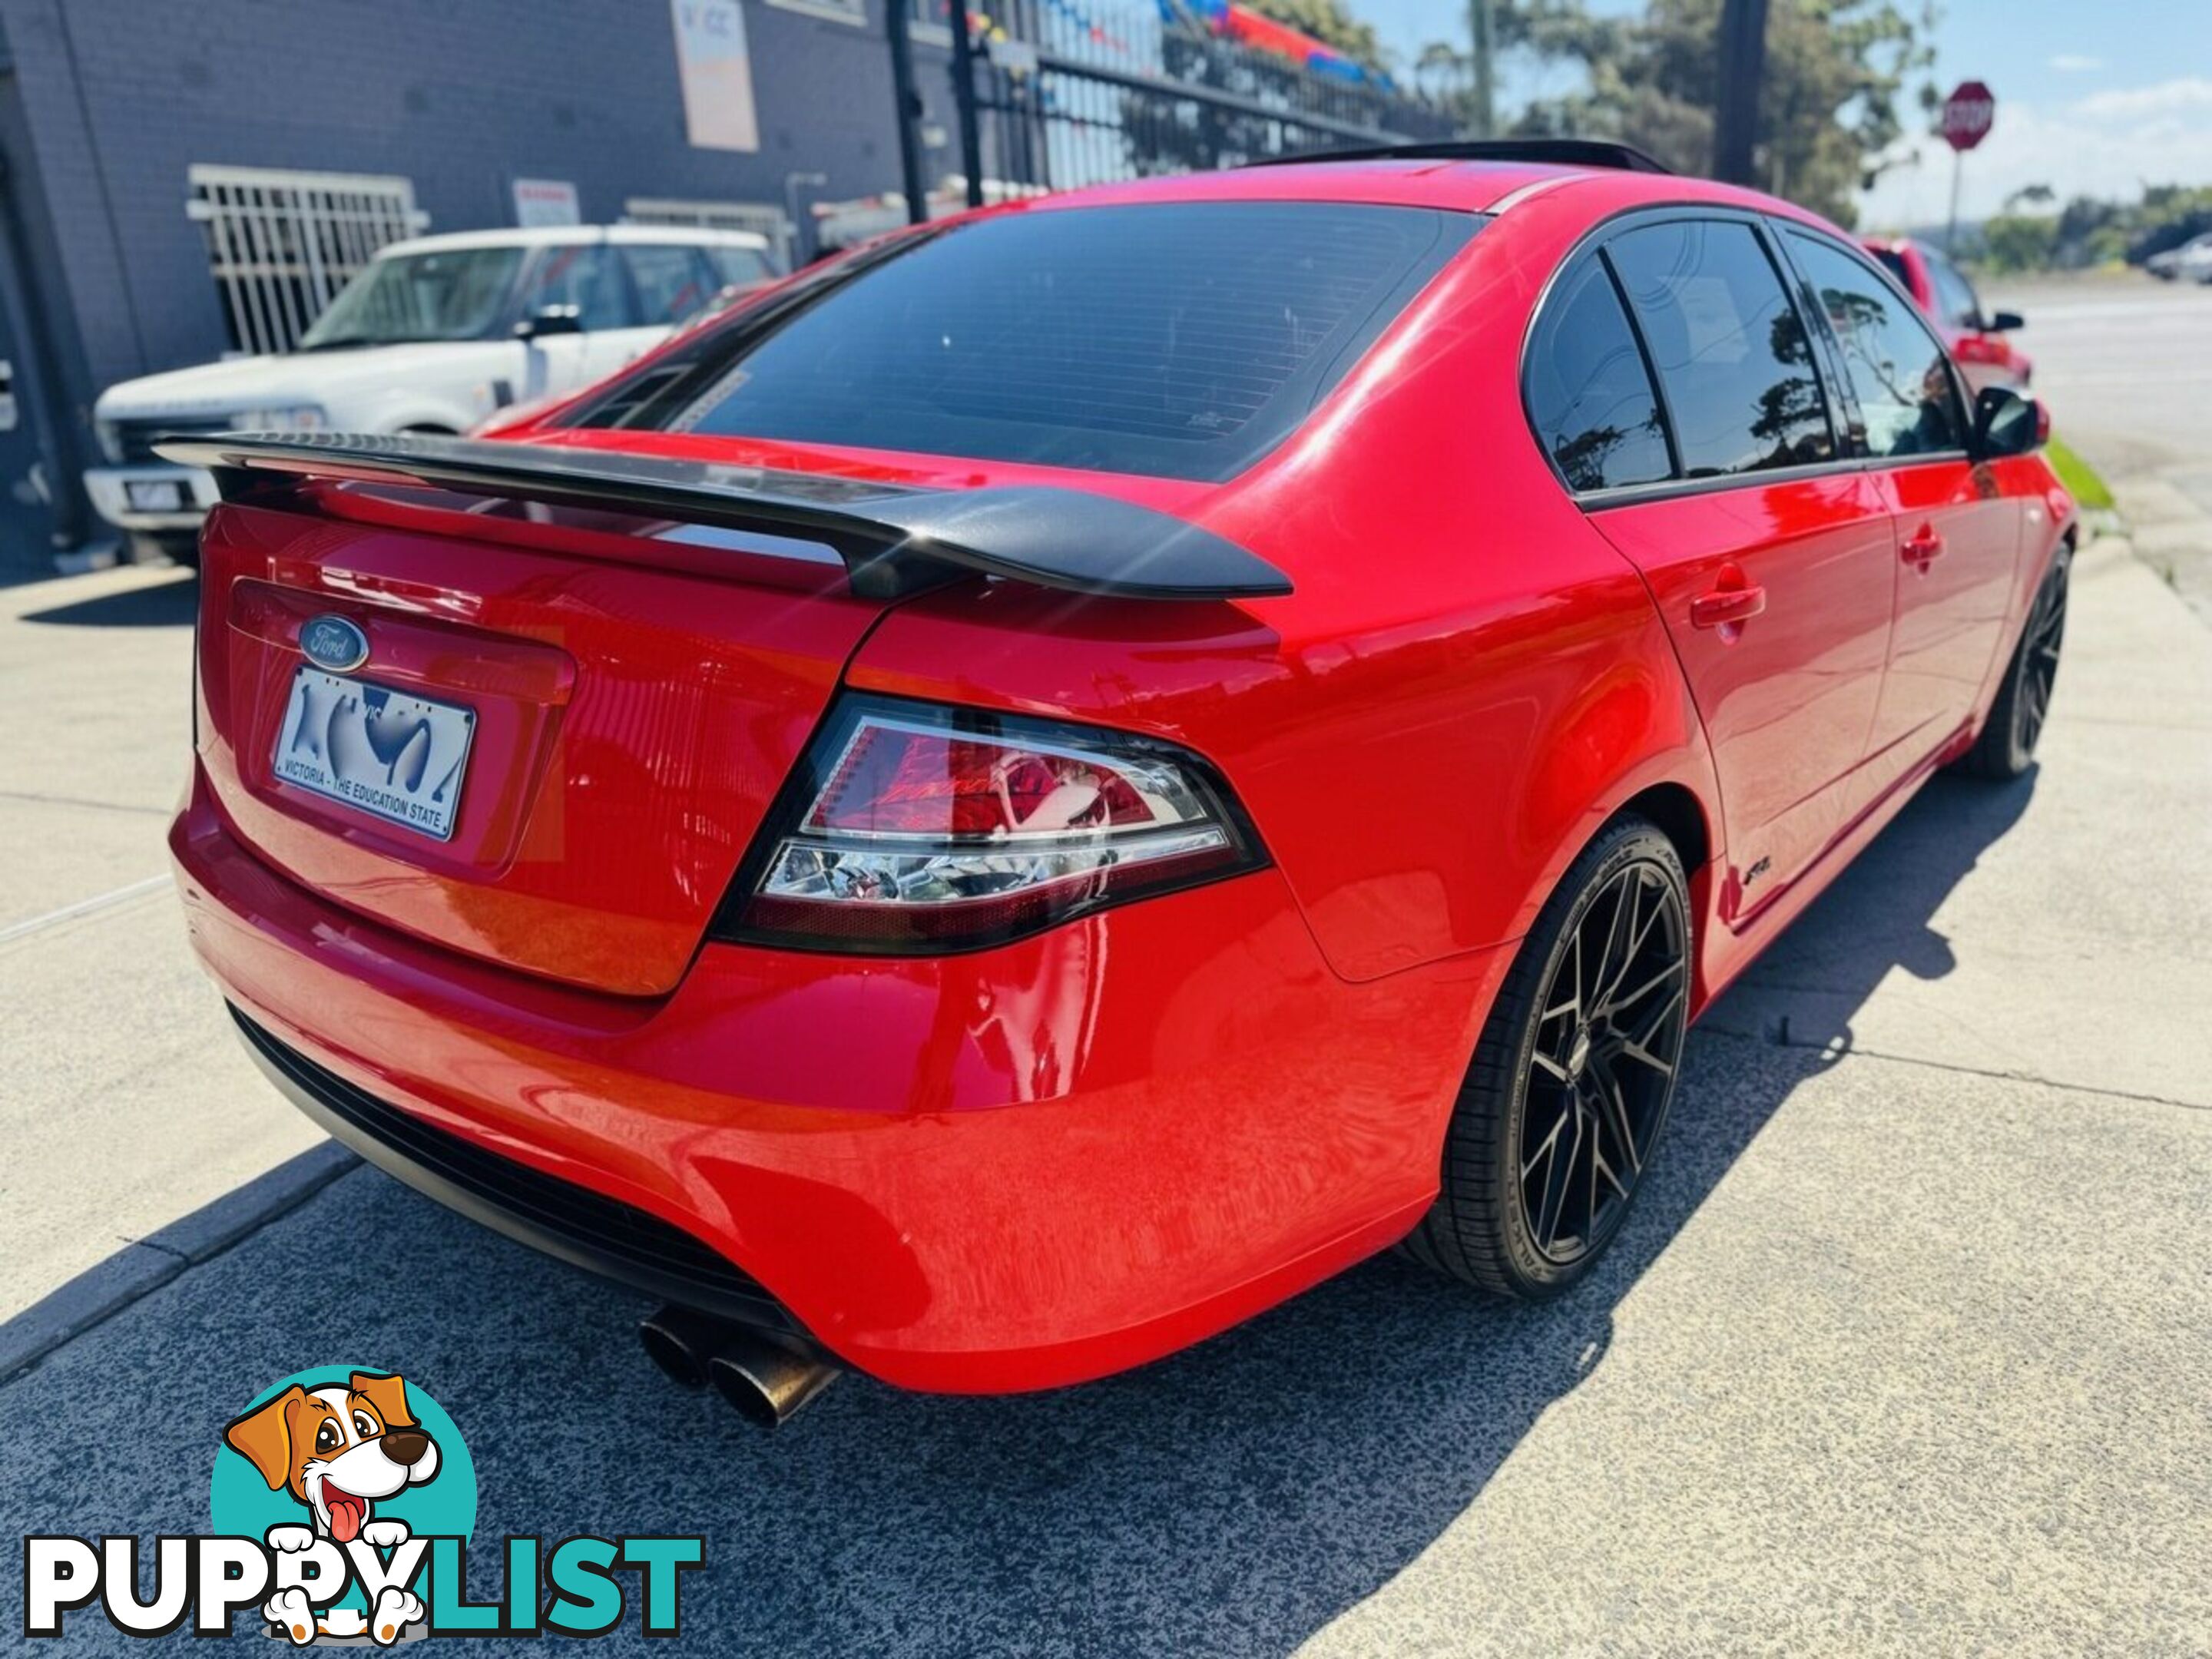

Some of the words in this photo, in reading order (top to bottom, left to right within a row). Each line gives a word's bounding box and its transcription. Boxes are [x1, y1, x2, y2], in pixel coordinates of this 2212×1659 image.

[310, 624, 348, 659] Ford
[284, 759, 324, 786] VICTORIA
[353, 784, 409, 816] EDUCATION
[409, 803, 442, 828] STATE
